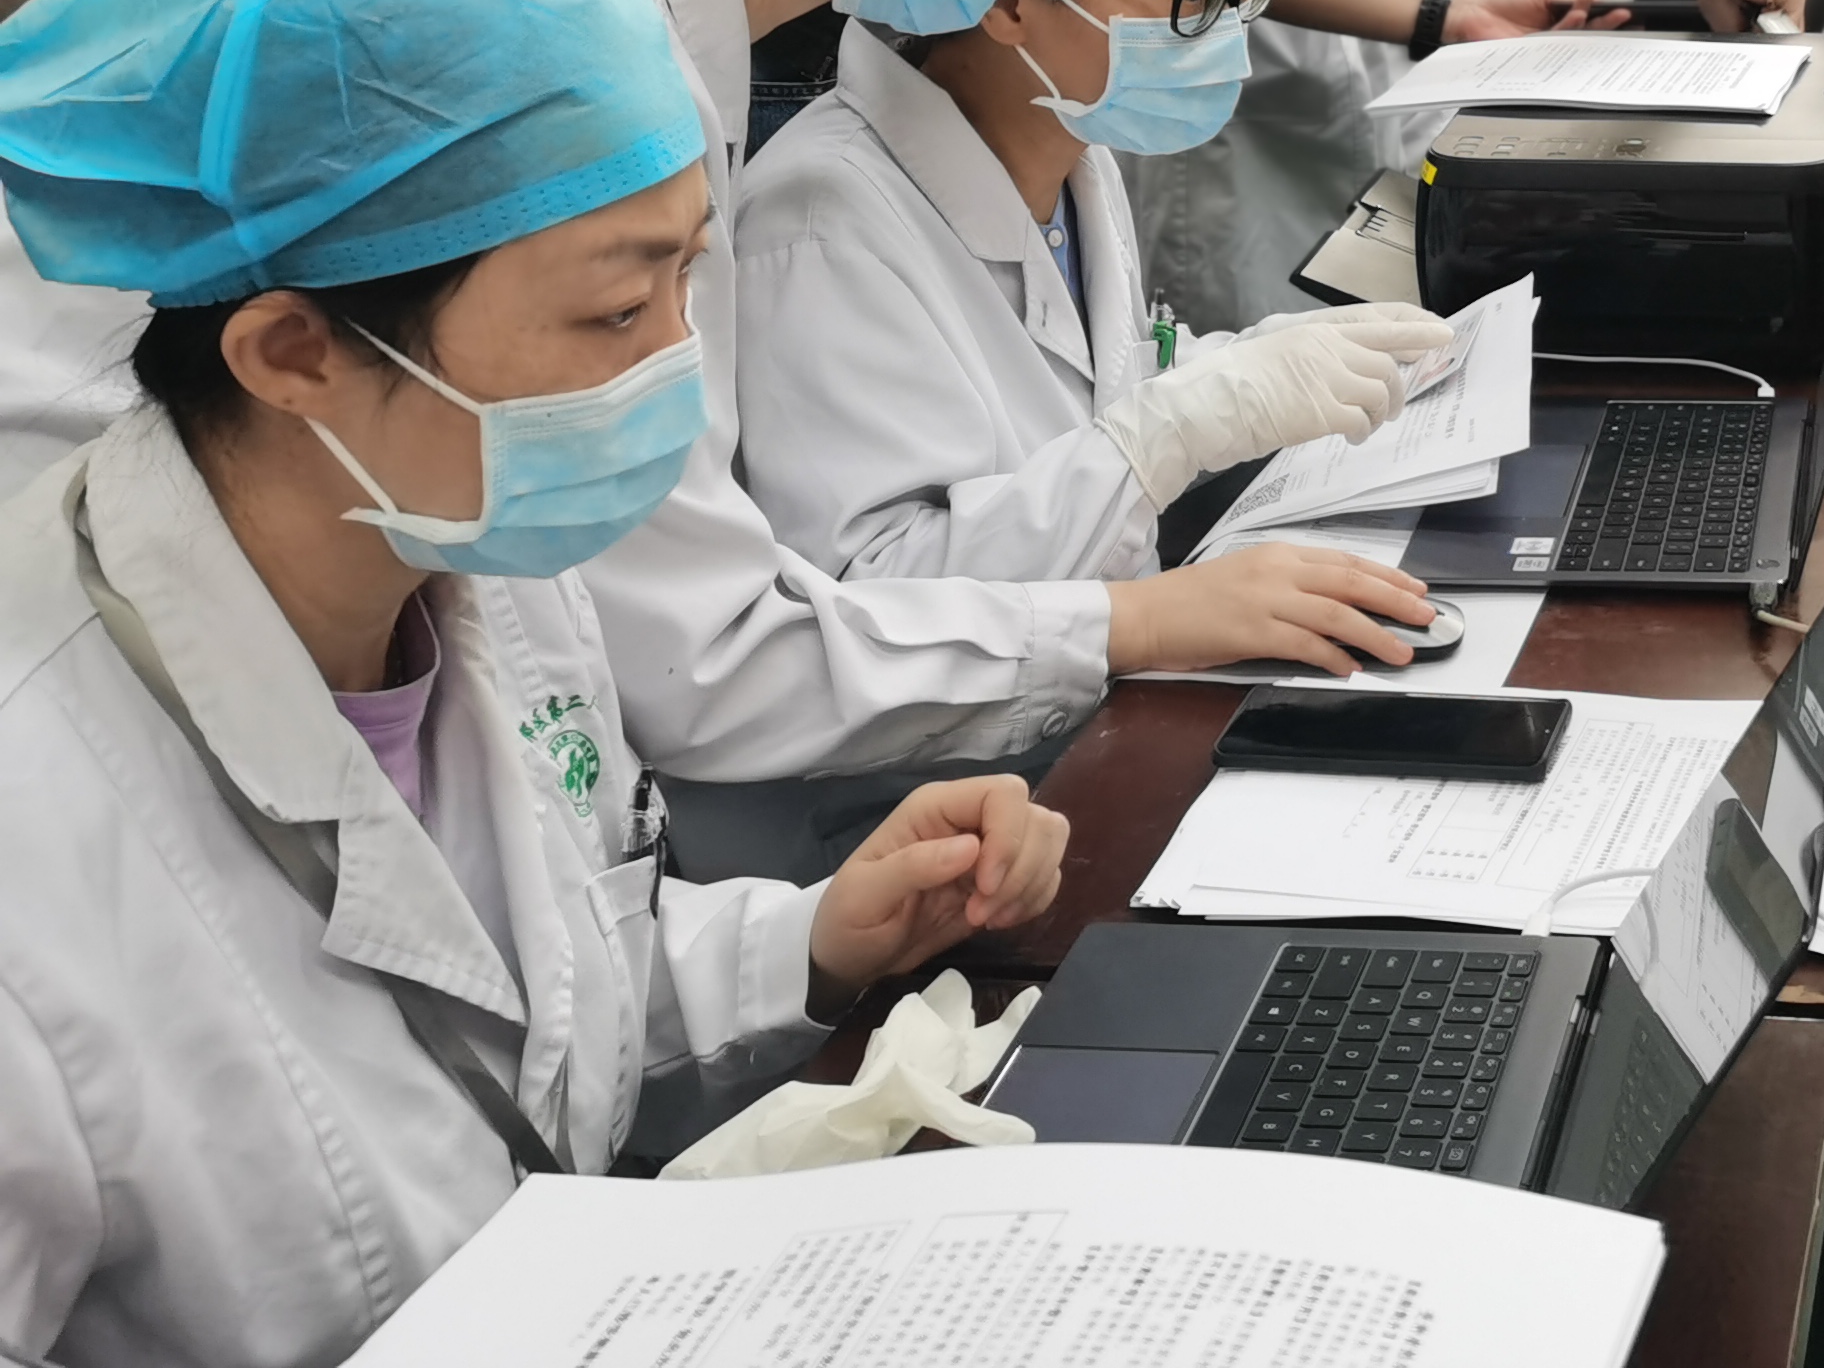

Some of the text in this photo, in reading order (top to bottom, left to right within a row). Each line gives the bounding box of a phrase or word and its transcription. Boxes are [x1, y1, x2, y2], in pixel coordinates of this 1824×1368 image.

[1416, 990, 1432, 1000] Q
[1367, 996, 1382, 1005] A
[1314, 1008, 1329, 1017] Z
[1407, 1016, 1422, 1027] W
[1357, 1023, 1371, 1031] S
[1301, 1035, 1316, 1043] X
[1345, 1050, 1360, 1059] D
[1288, 1063, 1303, 1073] C
[1384, 1073, 1400, 1081] R
[1333, 1079, 1347, 1087] F
[1276, 1092, 1292, 1101] V
[1373, 1102, 1389, 1110] T
[1319, 1108, 1334, 1117] G
[1262, 1122, 1278, 1131] B
[1409, 1118, 1424, 1126] 6
[1362, 1132, 1377, 1141] Y
[1305, 1138, 1322, 1148] H
